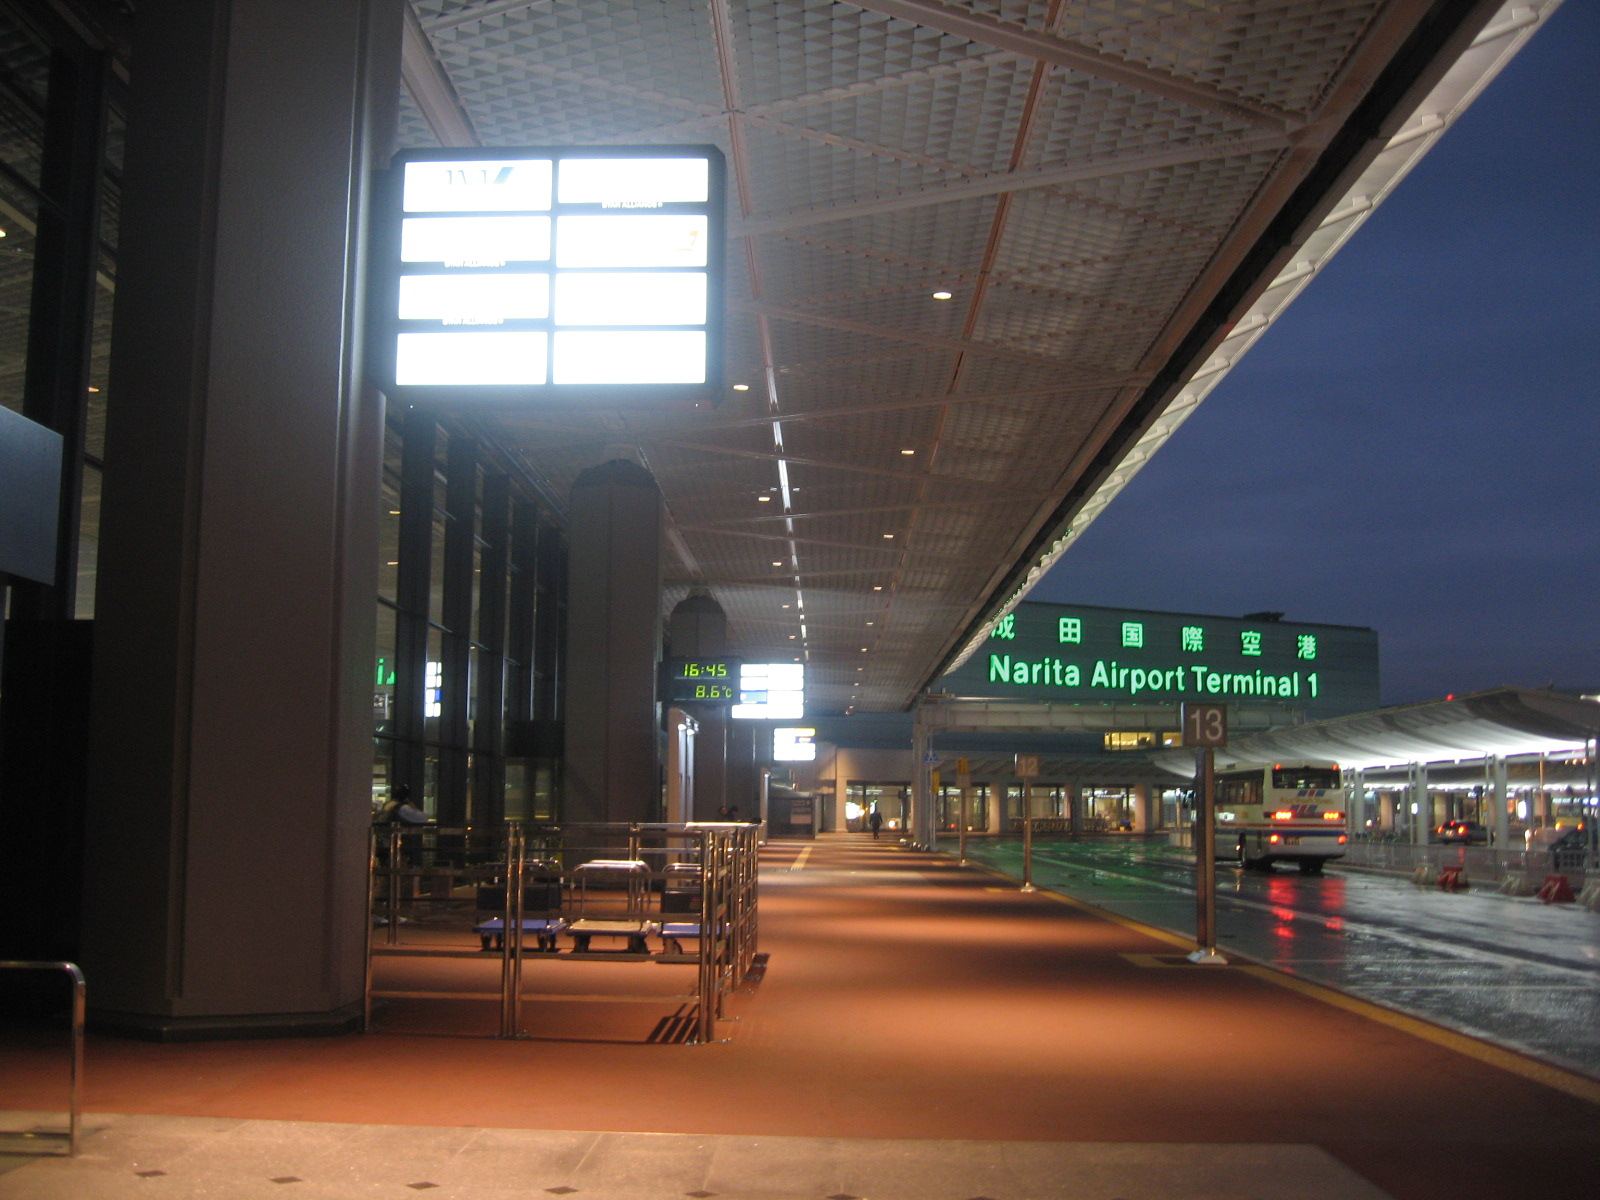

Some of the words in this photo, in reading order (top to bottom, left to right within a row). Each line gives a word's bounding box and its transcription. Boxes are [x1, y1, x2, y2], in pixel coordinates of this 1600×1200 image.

[990, 613, 1317, 660] 成田国際空港
[684, 663, 727, 677] 16:45
[989, 655, 1080, 687] Narita
[1091, 660, 1186, 695] Airport
[1190, 665, 1300, 697] Terminal
[1306, 672, 1318, 699] 1
[1190, 709, 1223, 741] 13
